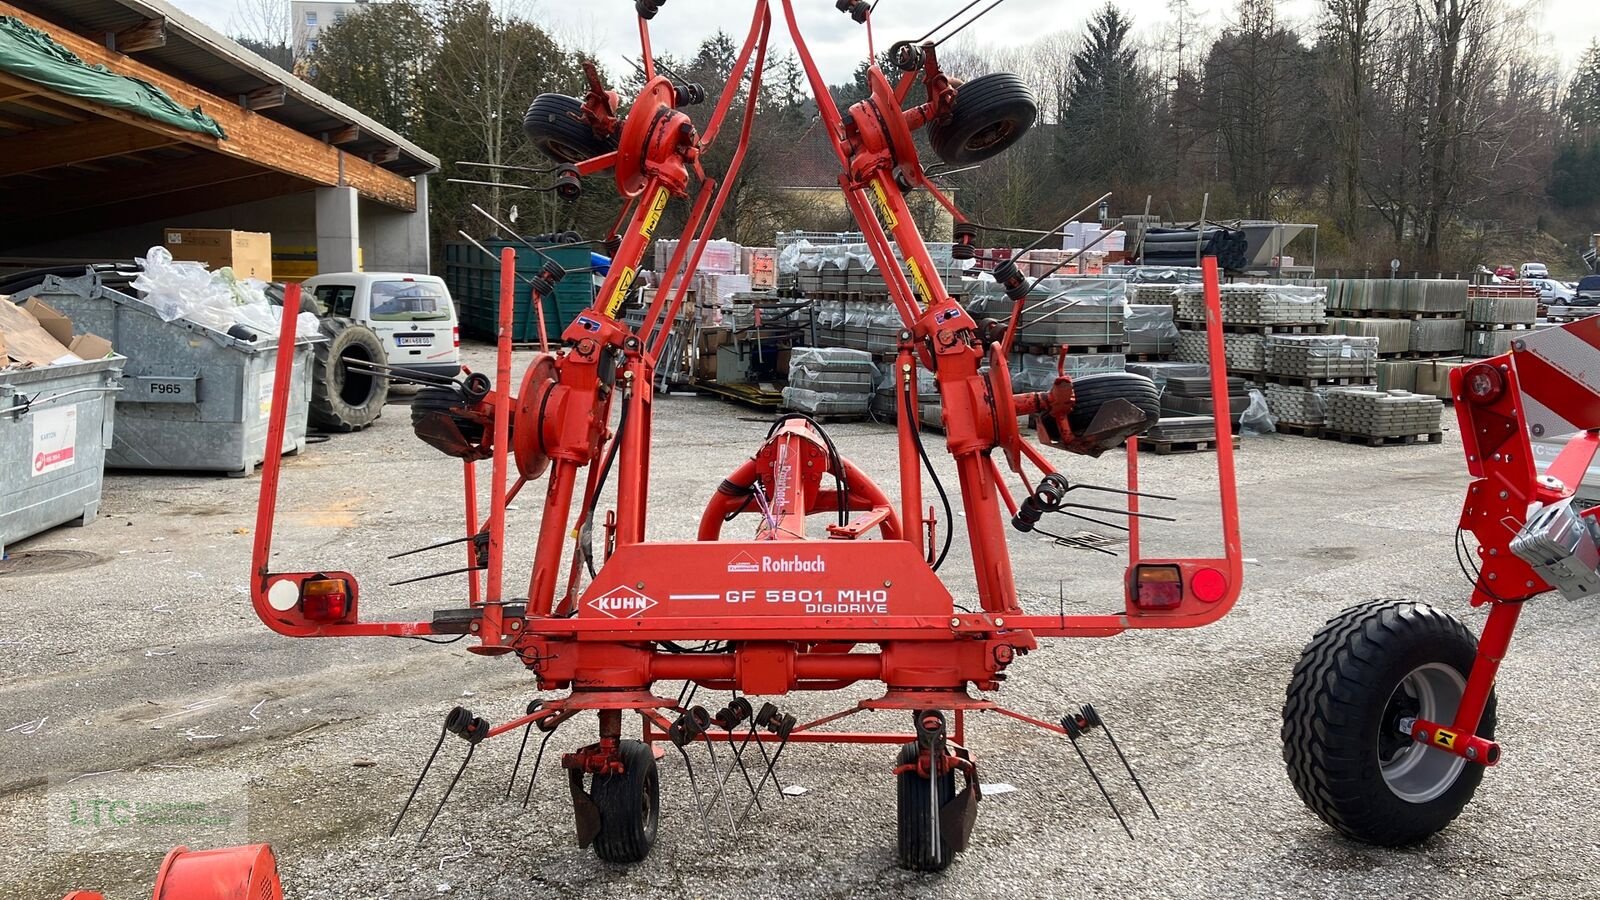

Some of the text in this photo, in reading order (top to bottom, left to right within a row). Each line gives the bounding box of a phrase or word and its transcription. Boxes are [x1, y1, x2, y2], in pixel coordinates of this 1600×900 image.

[150, 383, 181, 394] F965
[762, 555, 825, 572] Rohrbach
[726, 590, 887, 602] GF 5801 MHO
[599, 597, 647, 609] KUHN
[806, 604, 888, 613] DIGIDRIVE
